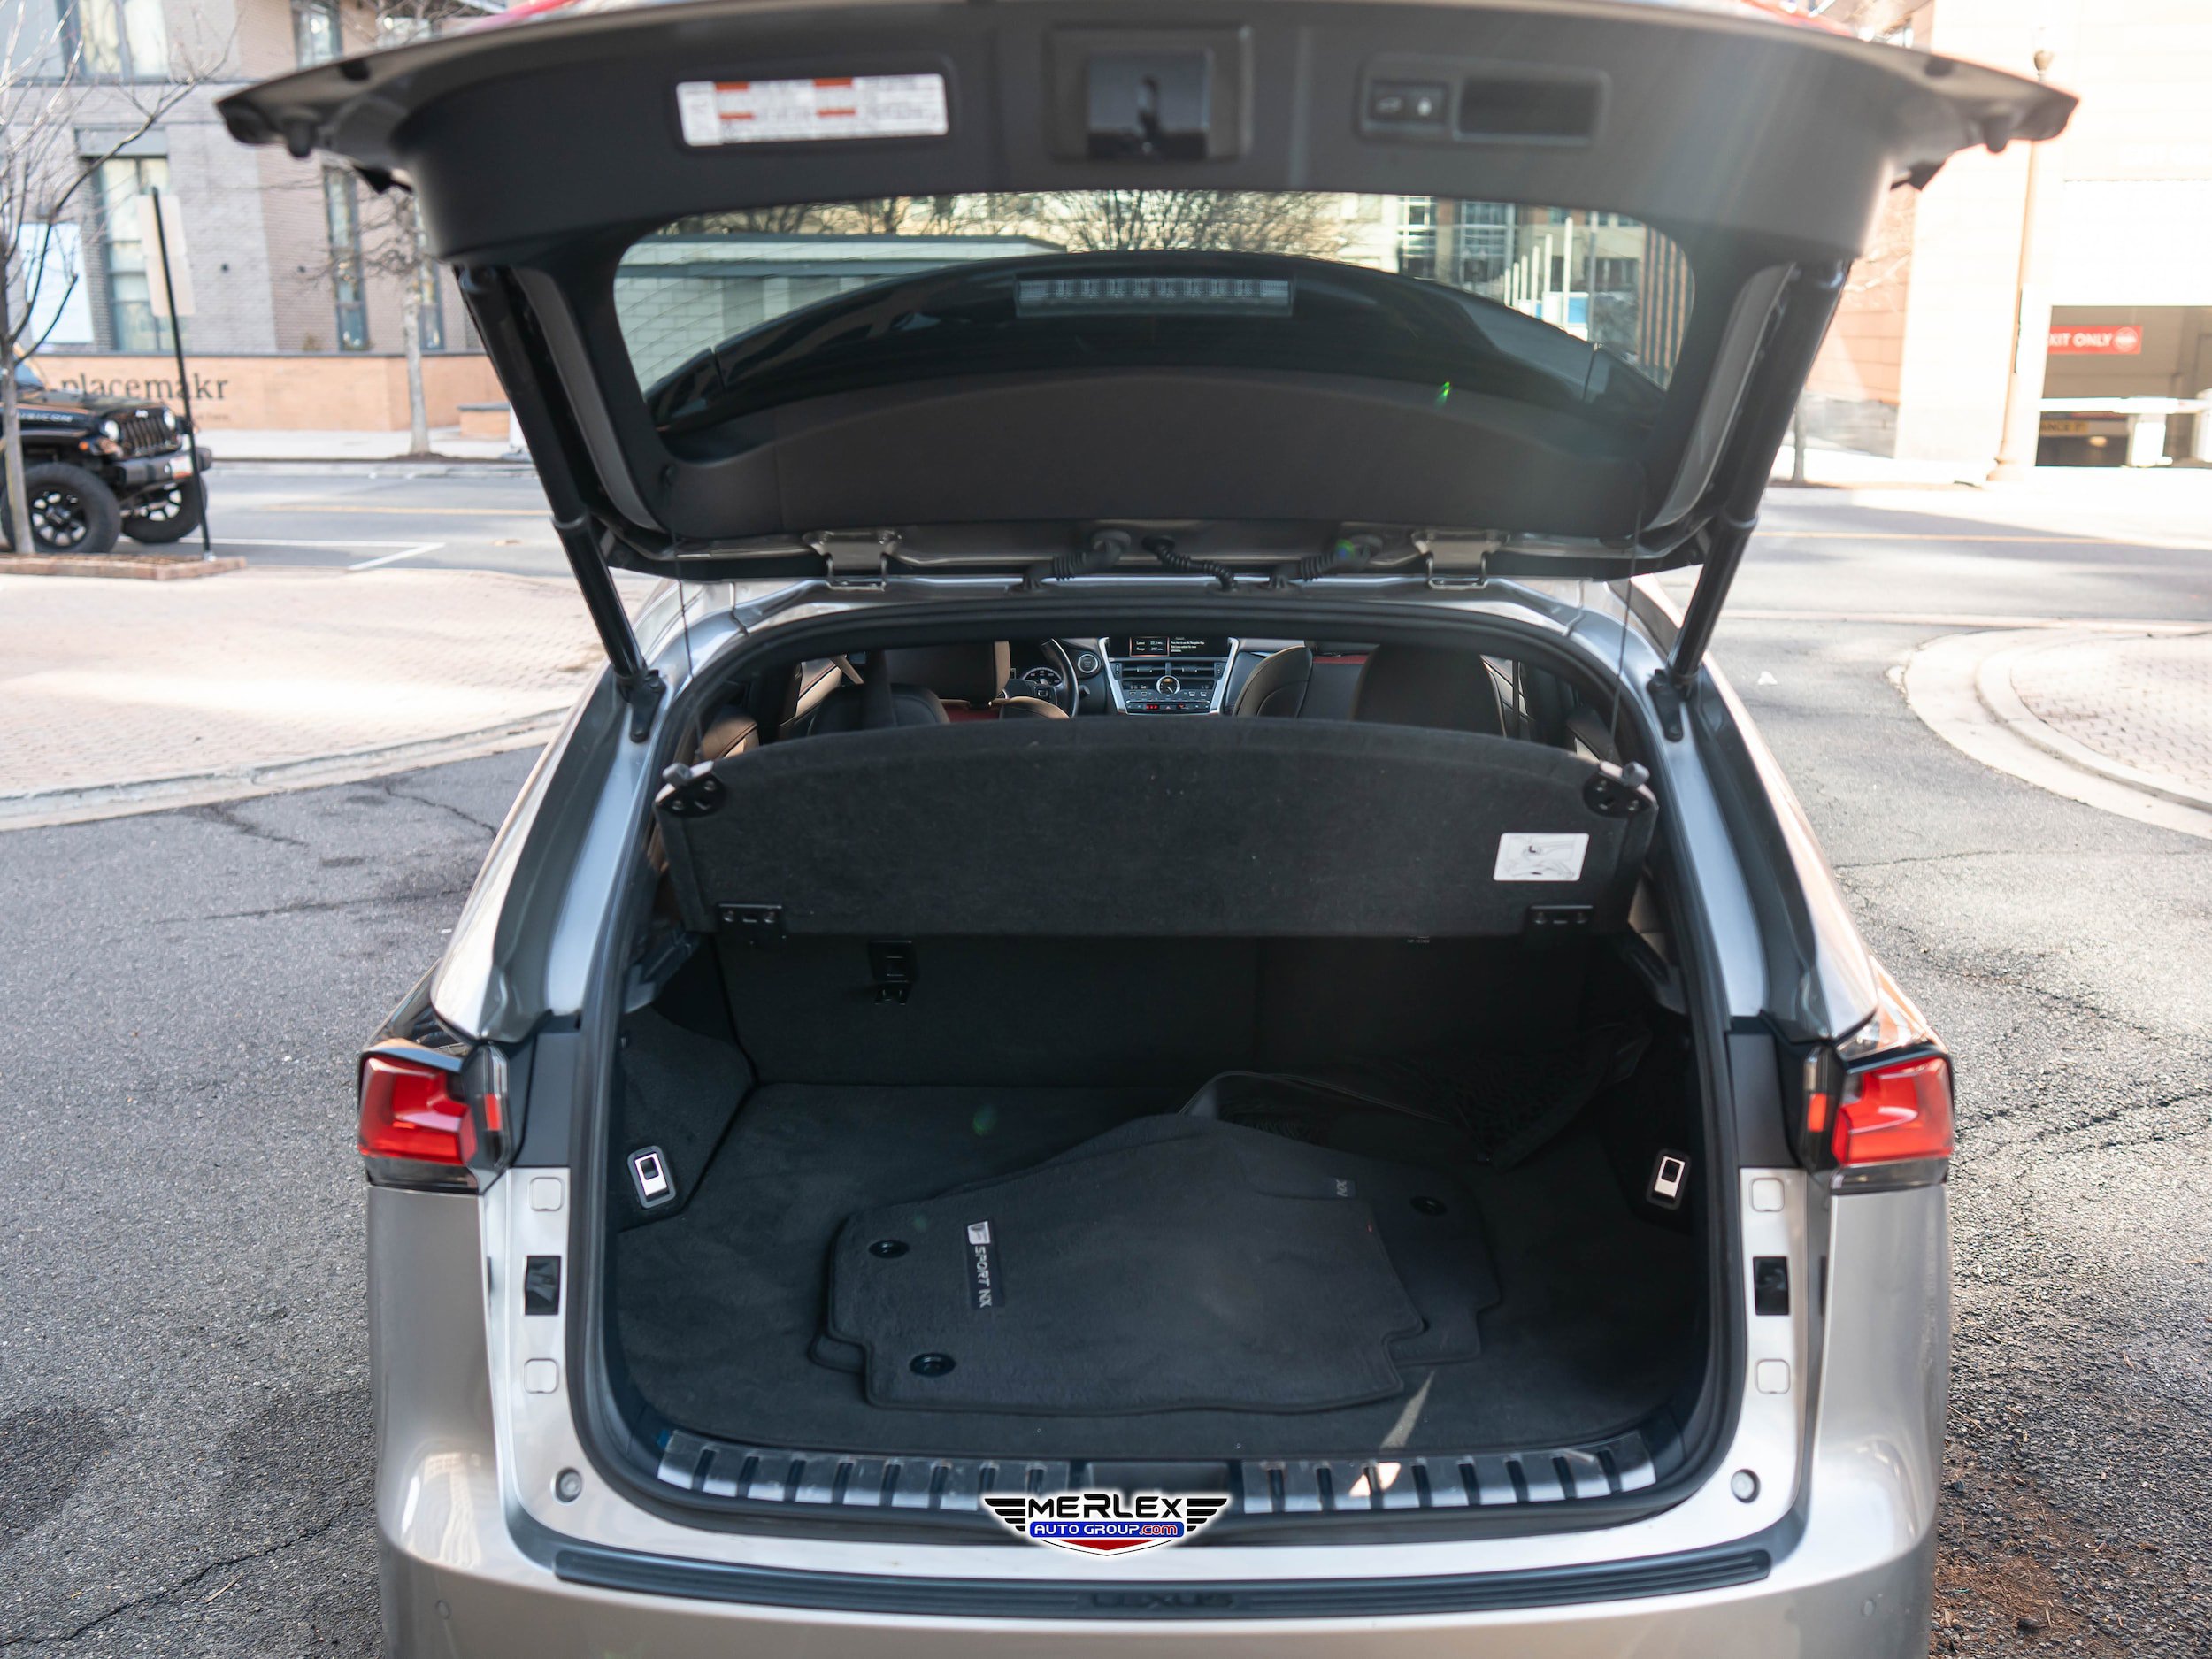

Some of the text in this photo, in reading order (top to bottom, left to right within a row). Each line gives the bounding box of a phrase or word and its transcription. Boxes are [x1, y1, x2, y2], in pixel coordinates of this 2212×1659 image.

[2047, 332, 2112, 347] XIT ONLY
[975, 1245, 991, 1287] SPORT
[978, 1289, 992, 1309] NX
